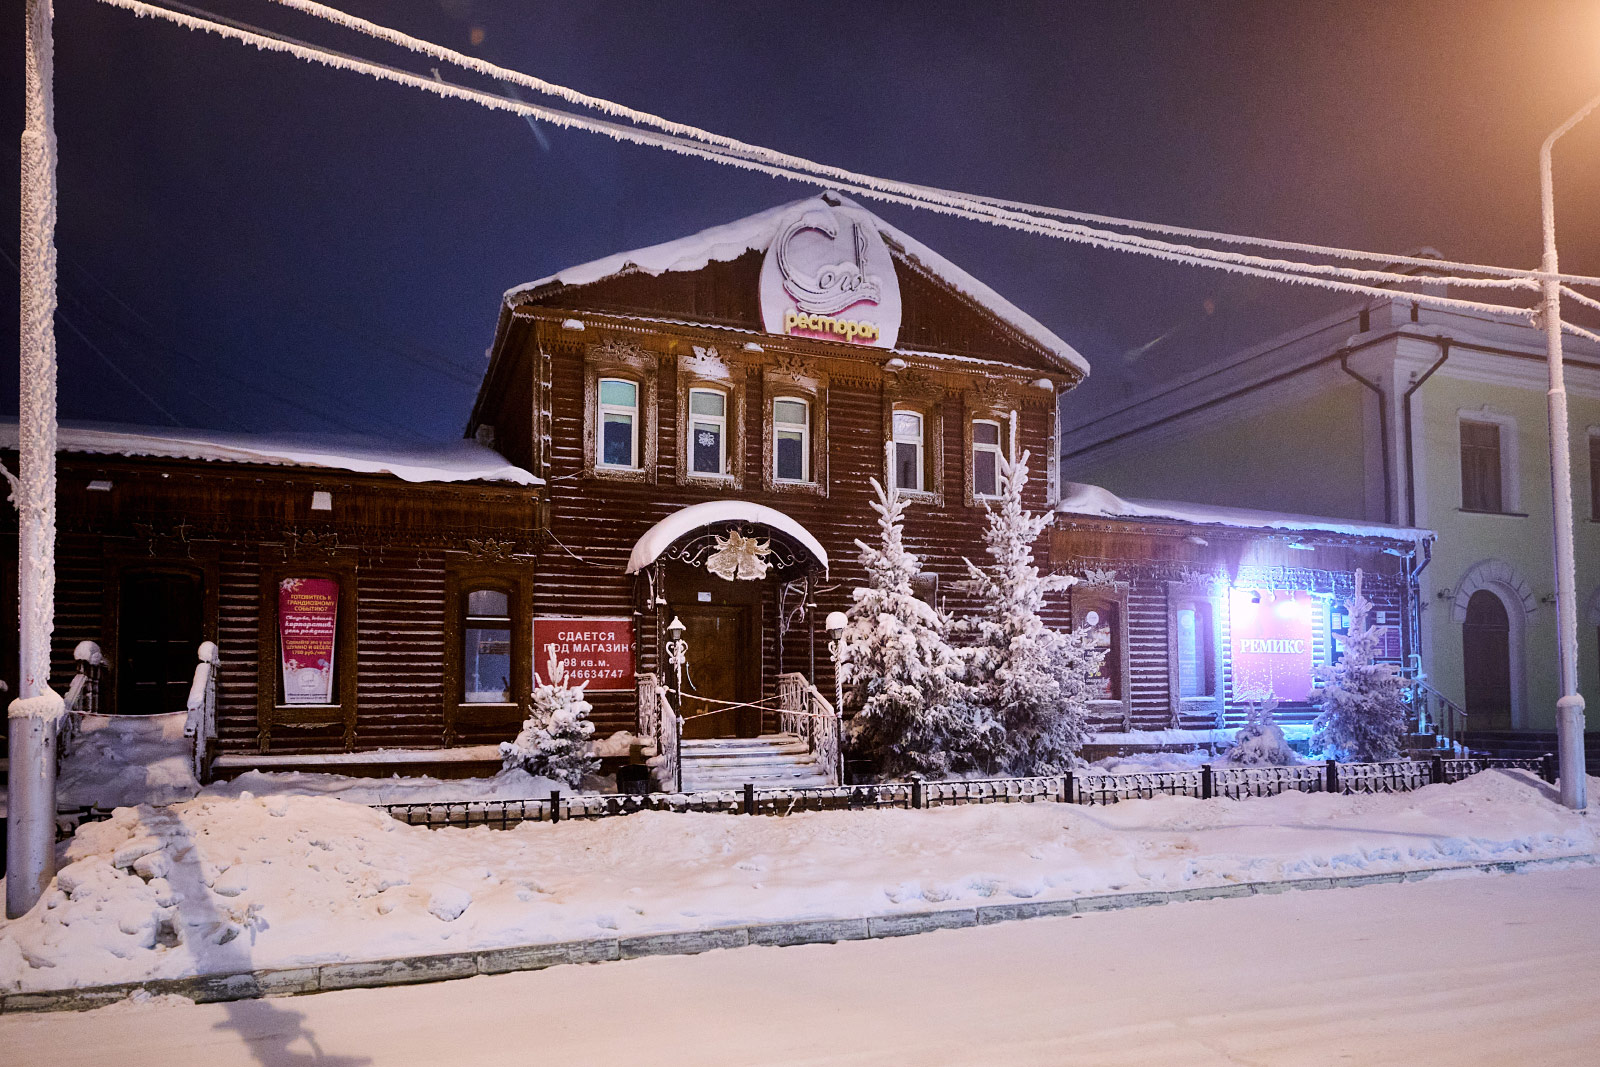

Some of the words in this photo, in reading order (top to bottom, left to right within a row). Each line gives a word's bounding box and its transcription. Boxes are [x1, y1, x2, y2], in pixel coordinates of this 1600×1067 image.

[785, 310, 879, 341] ресторан
[558, 632, 615, 642] СДАЕТСЯ
[573, 643, 629, 653] МАГАЗИН
[1240, 638, 1305, 654] РЕМИКС
[563, 658, 577, 667] 98
[555, 670, 623, 679] 246634747
